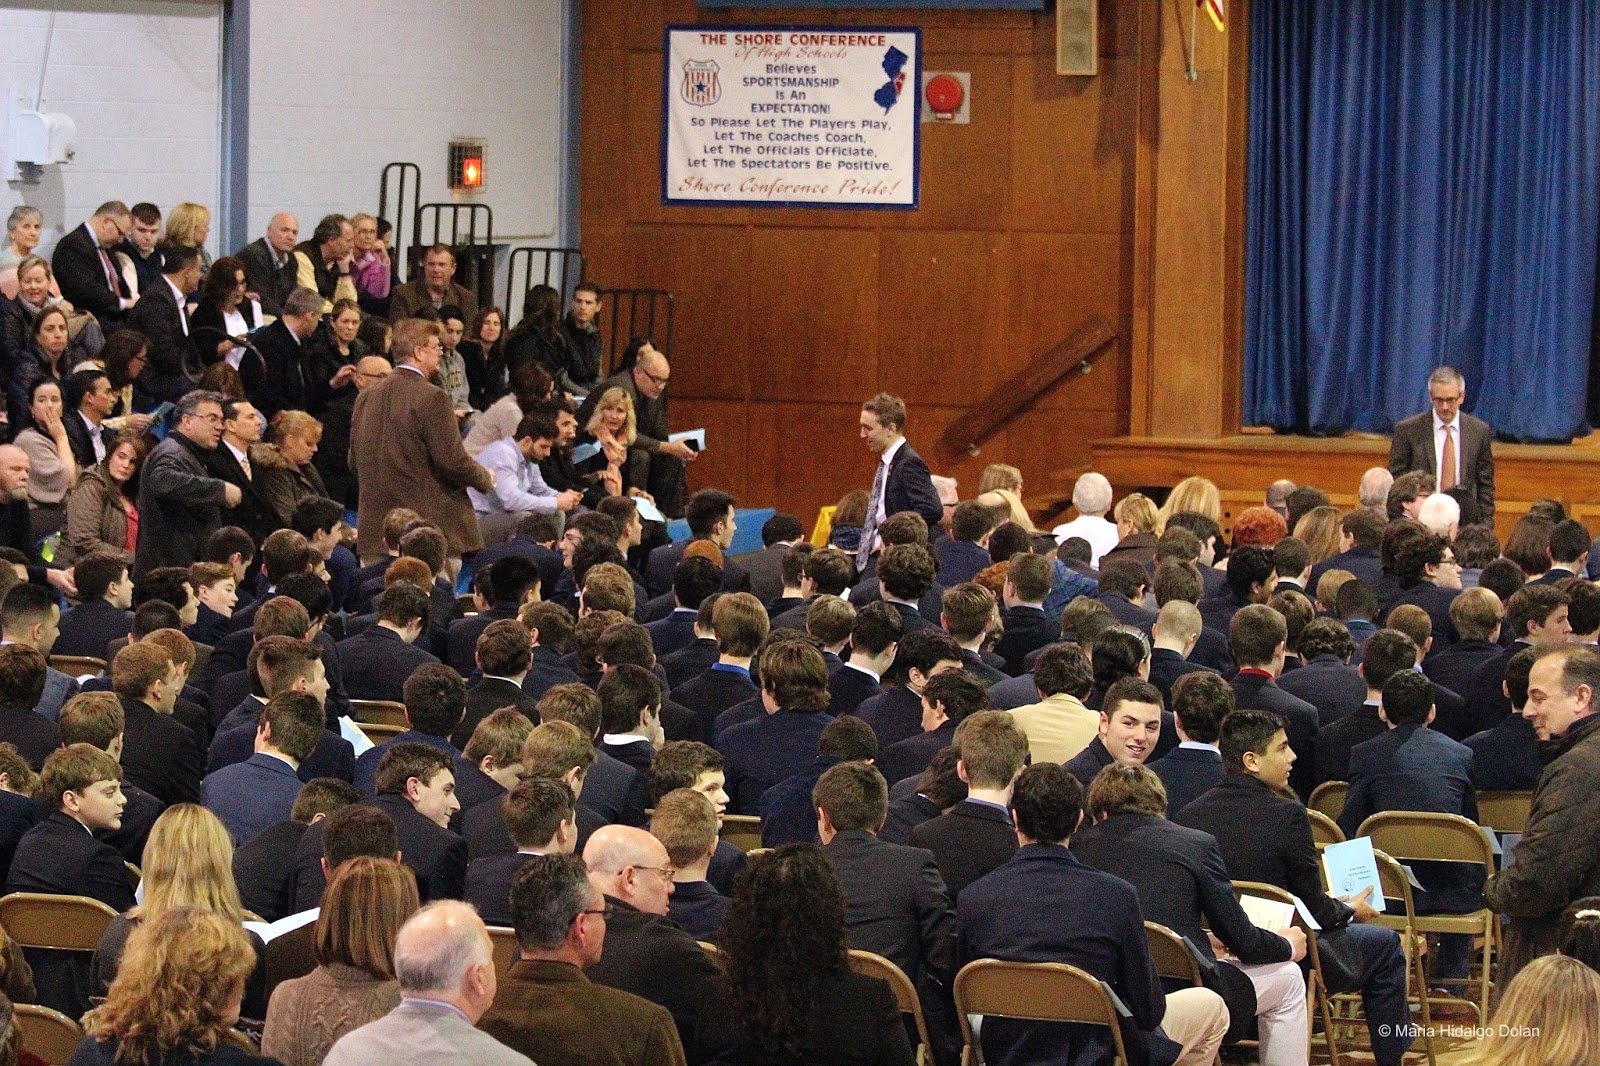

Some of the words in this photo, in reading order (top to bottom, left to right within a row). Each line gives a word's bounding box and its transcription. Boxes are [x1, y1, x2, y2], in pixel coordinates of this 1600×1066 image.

[700, 34, 727, 45] THE
[735, 34, 782, 46] SHORE
[790, 34, 886, 46] CONFERENCE
[735, 46, 757, 61] Of
[758, 46, 791, 61] High
[796, 47, 848, 59] Schools
[766, 64, 816, 74] Believes
[743, 77, 839, 87] SPORTSMANSHIP
[776, 90, 785, 100] Is
[790, 91, 806, 100] An
[751, 103, 831, 114] EXPECTATION!
[691, 117, 705, 127] So
[711, 117, 751, 127] Please
[756, 119, 776, 128] Let
[782, 119, 804, 128] The
[810, 119, 856, 130] Players
[862, 119, 891, 131] Play,
[715, 131, 734, 140] Let
[741, 132, 762, 140] The
[768, 132, 819, 142] Coaches
[826, 133, 866, 144] Coach,
[704, 145, 724, 154] Let
[729, 145, 751, 154] The
[757, 146, 810, 155] Officials
[816, 147, 877, 157] Officiate,
[688, 158, 707, 167] Let
[714, 159, 735, 168] The
[742, 159, 811, 169] Spectators
[817, 160, 832, 169] Be
[838, 161, 893, 171] Positive.
[678, 176, 731, 193] Shore
[739, 177, 829, 198] Conference
[838, 179, 901, 195] Pride!
